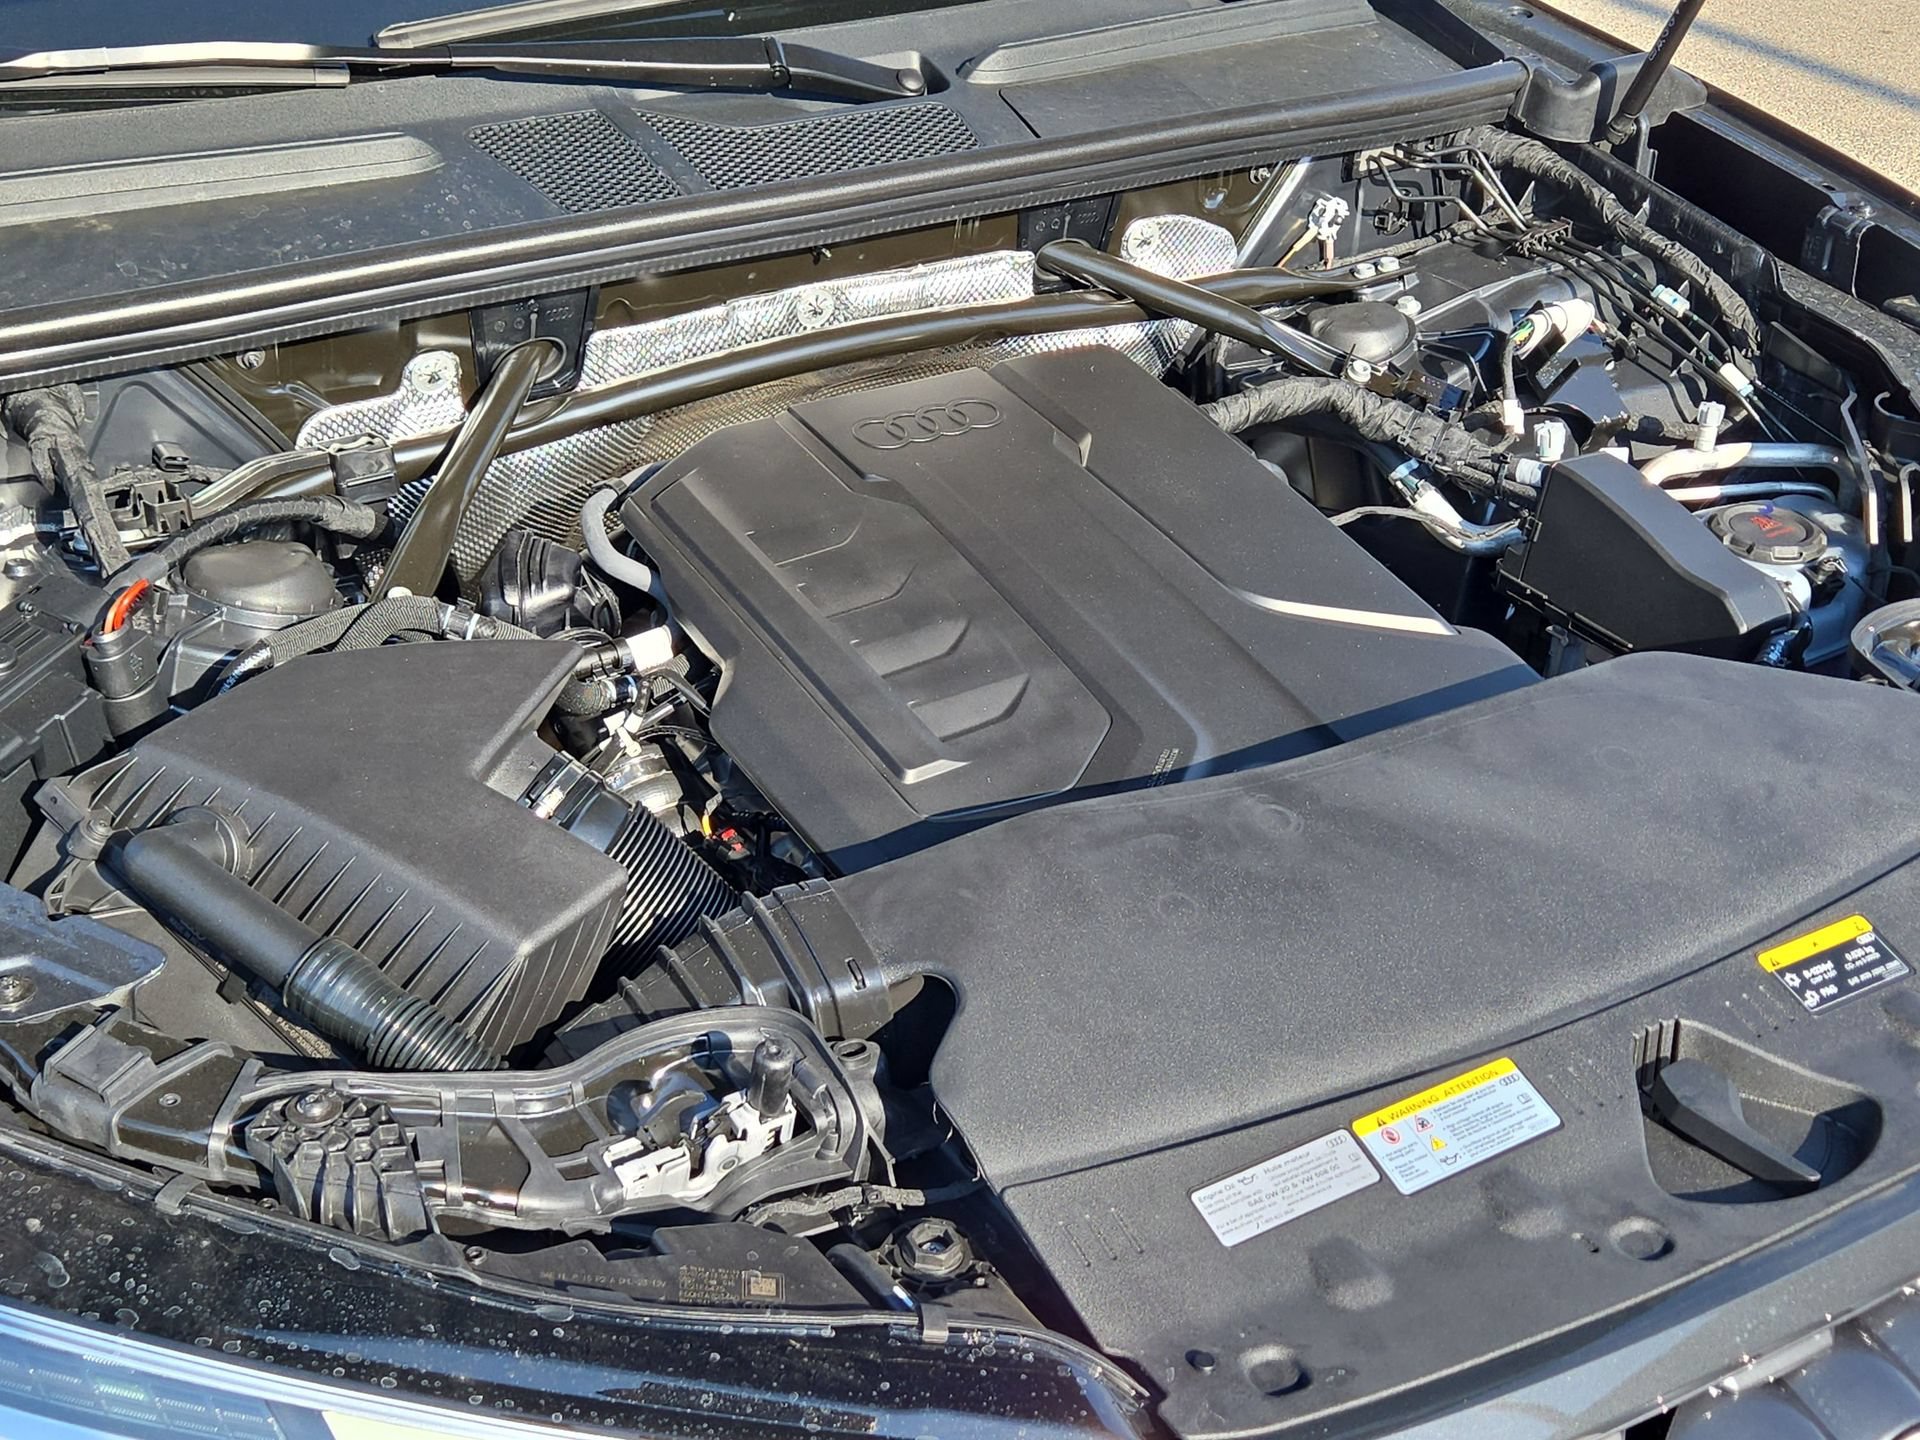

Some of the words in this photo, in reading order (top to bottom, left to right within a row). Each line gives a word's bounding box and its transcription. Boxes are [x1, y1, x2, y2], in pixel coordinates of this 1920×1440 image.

[1390, 1096, 1439, 1120] WARNING
[1444, 1070, 1498, 1096] ATTENTION
[1198, 1189, 1223, 1203] Engine
[1264, 1164, 1282, 1174] Huile
[1284, 1152, 1310, 1166] moteur
[1248, 1197, 1263, 1206] SAE
[1302, 1175, 1313, 1184] VW
